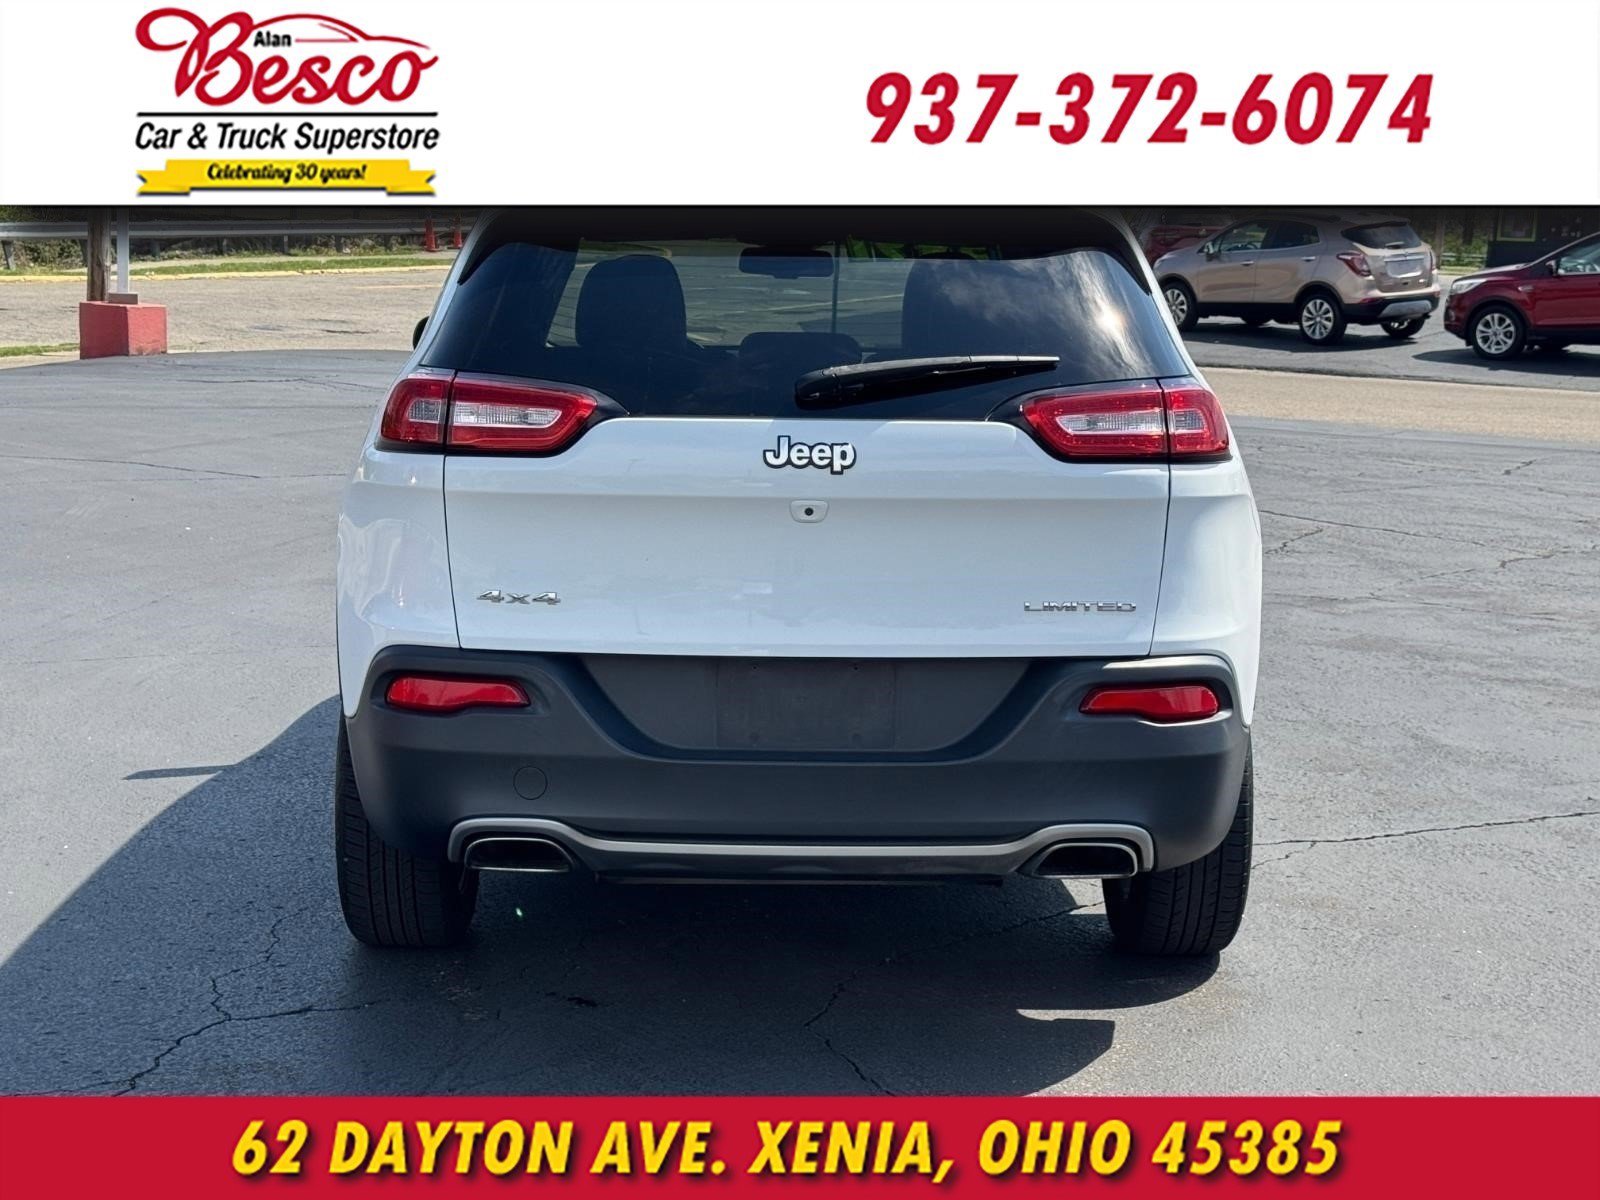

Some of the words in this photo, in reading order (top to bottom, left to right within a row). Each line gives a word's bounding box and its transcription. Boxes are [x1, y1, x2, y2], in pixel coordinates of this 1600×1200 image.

[763, 435, 856, 475] Jeep
[476, 589, 562, 605] 4x4
[1023, 601, 1137, 612] LIMITED
